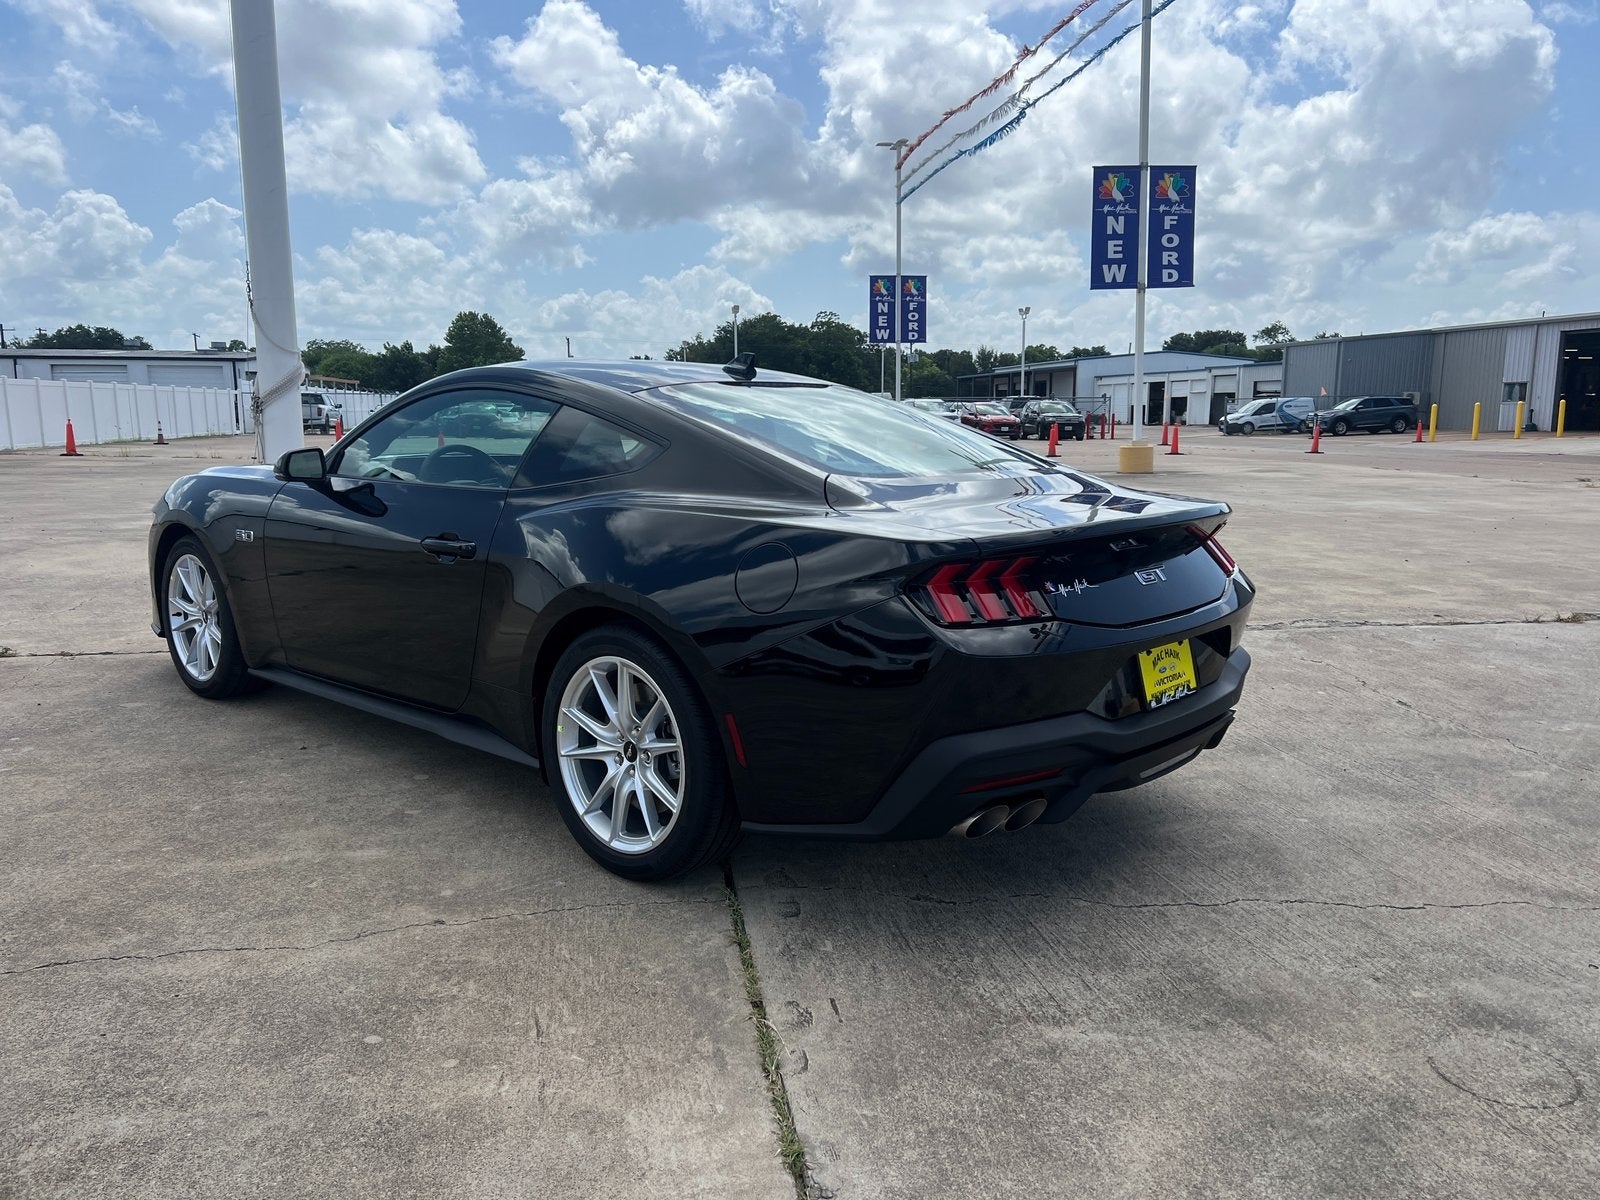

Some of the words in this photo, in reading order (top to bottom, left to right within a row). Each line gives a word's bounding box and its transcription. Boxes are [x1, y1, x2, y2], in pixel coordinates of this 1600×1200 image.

[1102, 216, 1127, 283] NEW
[1161, 215, 1180, 283] FORD
[876, 302, 890, 340] NEW
[908, 303, 919, 340] FORD
[1133, 565, 1167, 585] GT
[1152, 650, 1164, 671] MAC
[1165, 648, 1181, 661] HAIK
